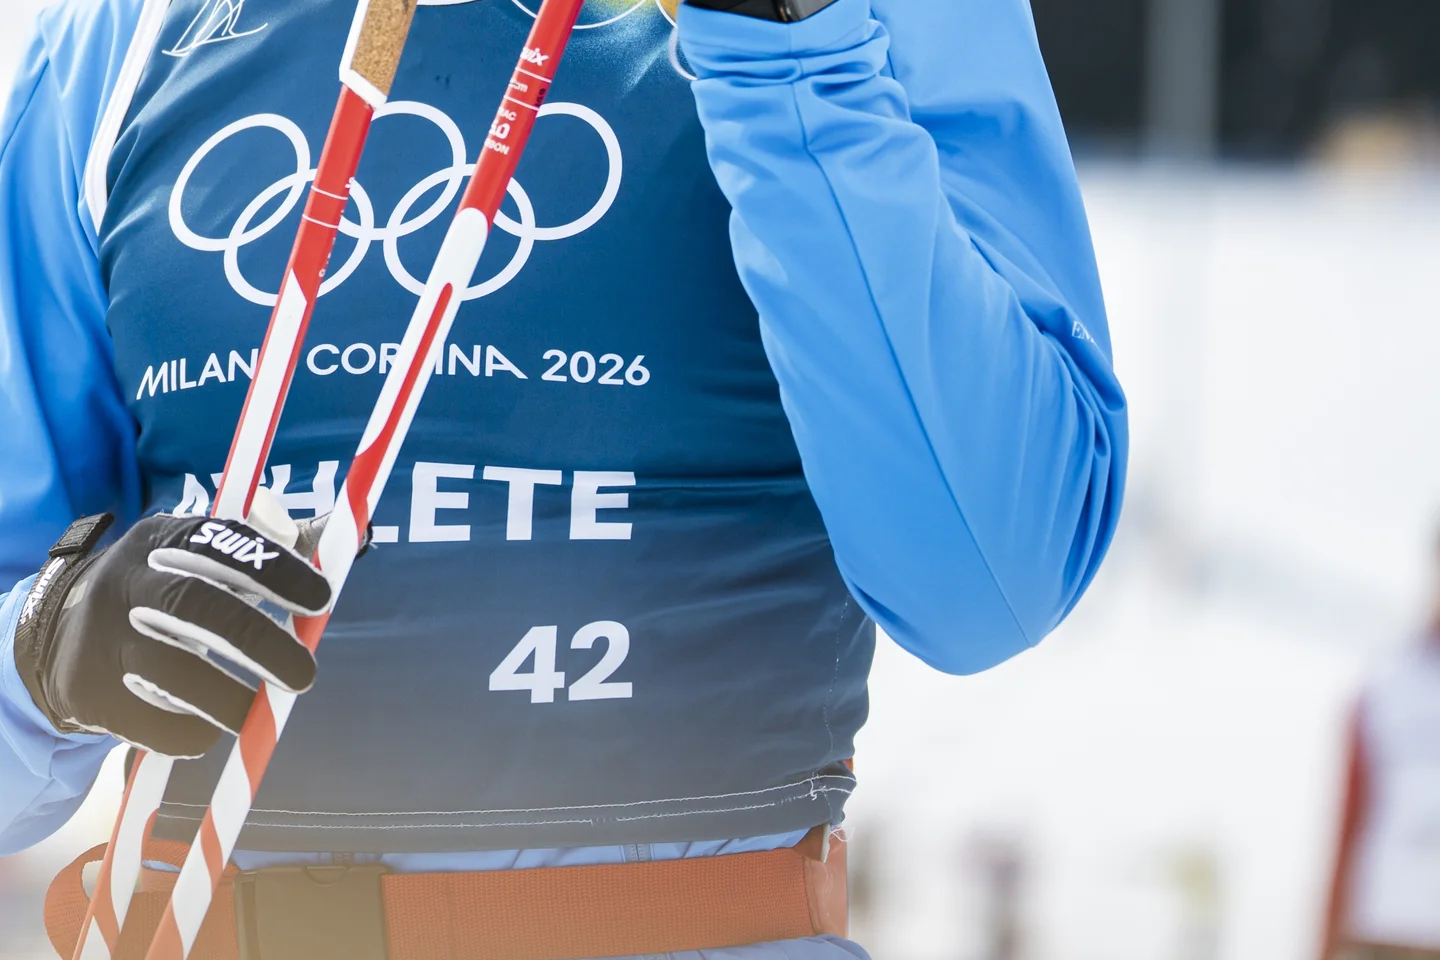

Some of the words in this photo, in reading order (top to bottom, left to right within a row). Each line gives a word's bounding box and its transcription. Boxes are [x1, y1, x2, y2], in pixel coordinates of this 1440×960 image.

[135, 347, 260, 401] MILAN
[305, 342, 529, 380] CORINA
[541, 347, 651, 387] 2026
[172, 460, 637, 543] AHETE
[488, 620, 634, 704] 42
